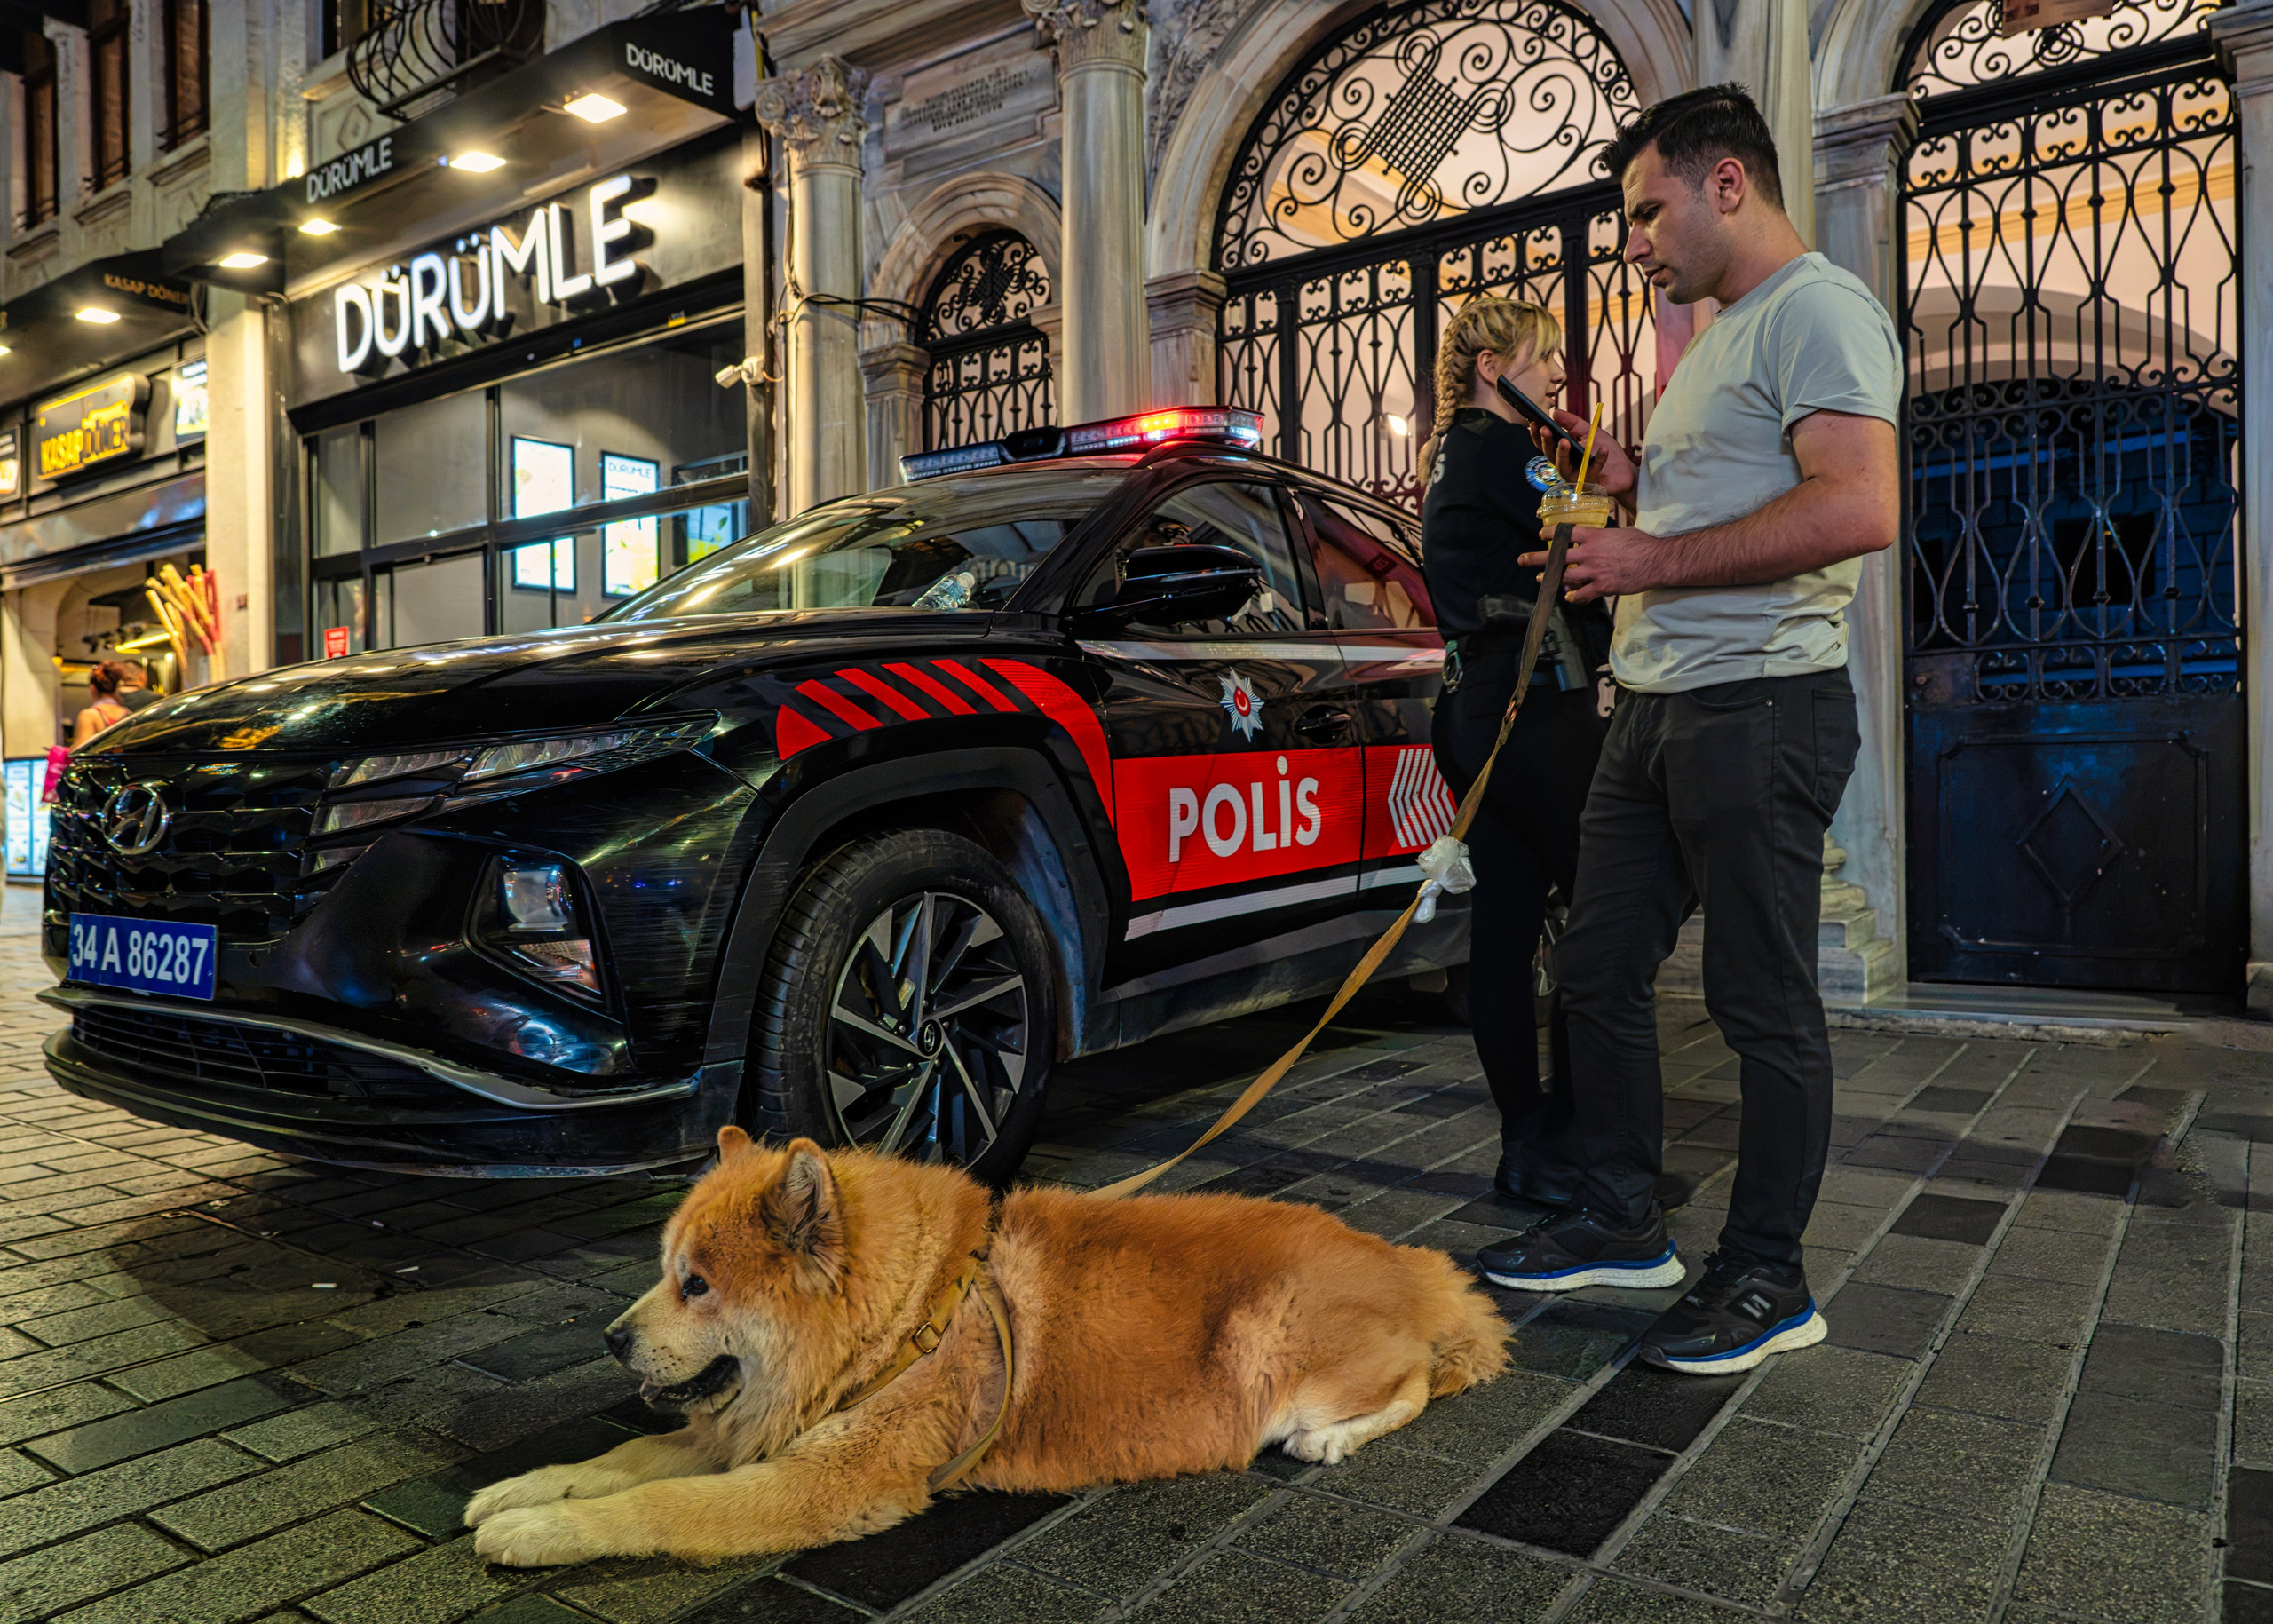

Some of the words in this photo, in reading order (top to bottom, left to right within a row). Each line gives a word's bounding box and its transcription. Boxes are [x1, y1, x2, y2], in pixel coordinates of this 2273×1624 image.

[625, 42, 715, 97] DÜRÜMLE
[305, 136, 393, 205] DÜRÜMLE
[334, 173, 637, 374] DÜRÜMLE
[1168, 755, 1321, 863] POLİS
[72, 923, 98, 969] 34
[100, 927, 122, 974] A
[127, 930, 209, 986] 86287
